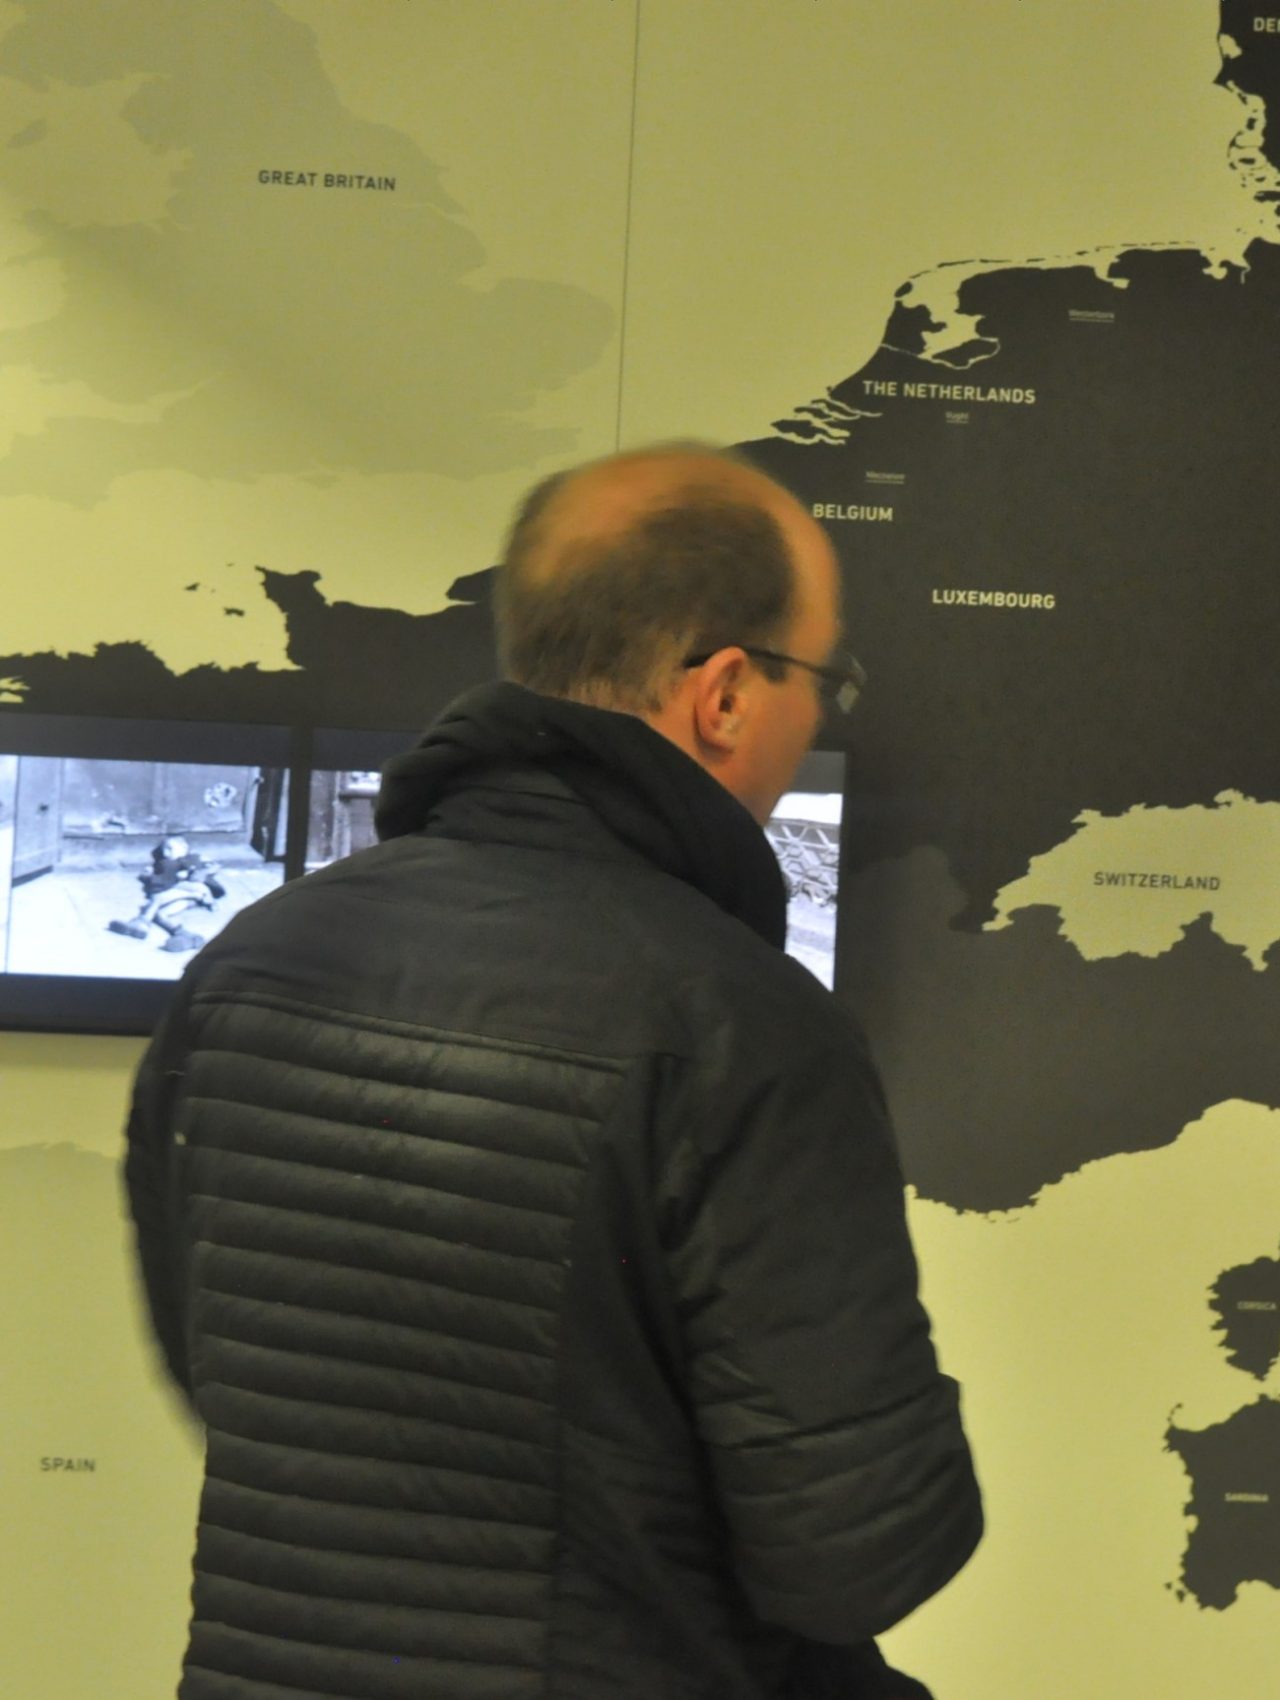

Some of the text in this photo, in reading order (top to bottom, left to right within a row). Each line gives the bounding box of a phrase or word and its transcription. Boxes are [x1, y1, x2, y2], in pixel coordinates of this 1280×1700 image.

[258, 169, 396, 191] GREAT BRITAIN
[863, 380, 1036, 405] THE NETHERLANDS
[812, 504, 893, 521] BELGIUM
[932, 589, 1056, 610] LUXEMBOURG
[1093, 871, 1221, 891] SWITZERLAND
[40, 1456, 96, 1473] SPAIN
